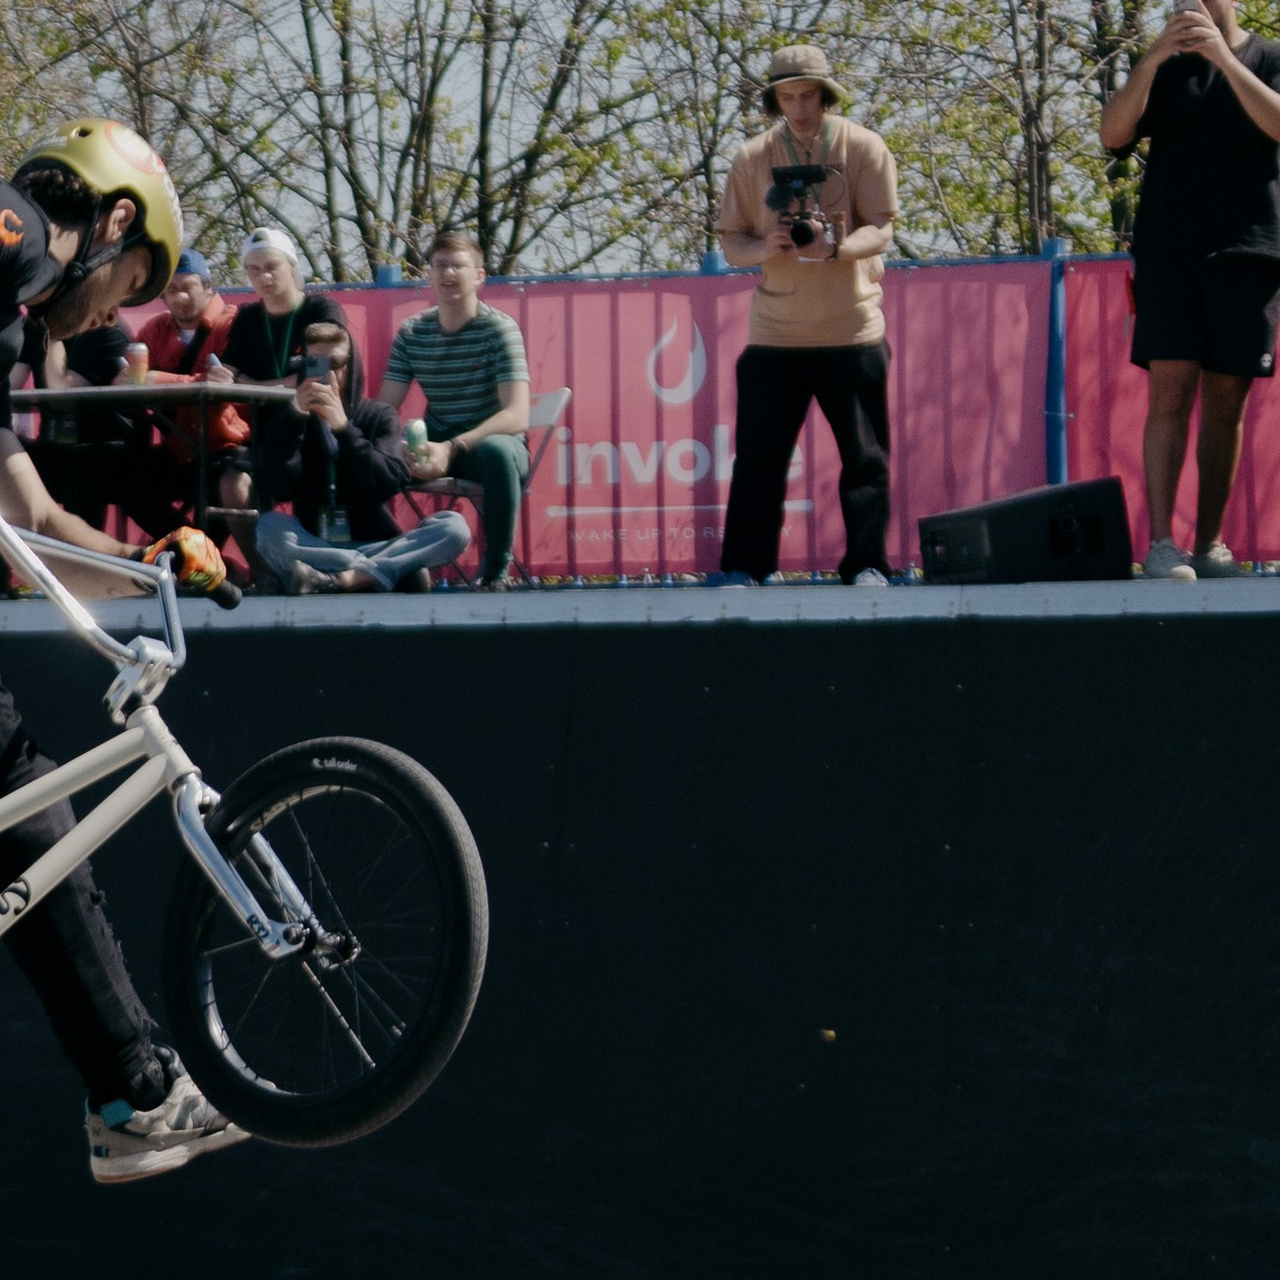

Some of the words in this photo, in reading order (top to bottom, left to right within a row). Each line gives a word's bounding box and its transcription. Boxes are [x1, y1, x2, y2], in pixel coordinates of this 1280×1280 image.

[570, 528, 629, 541] WAKE
[636, 527, 662, 539] UP
[670, 526, 696, 538] TO
